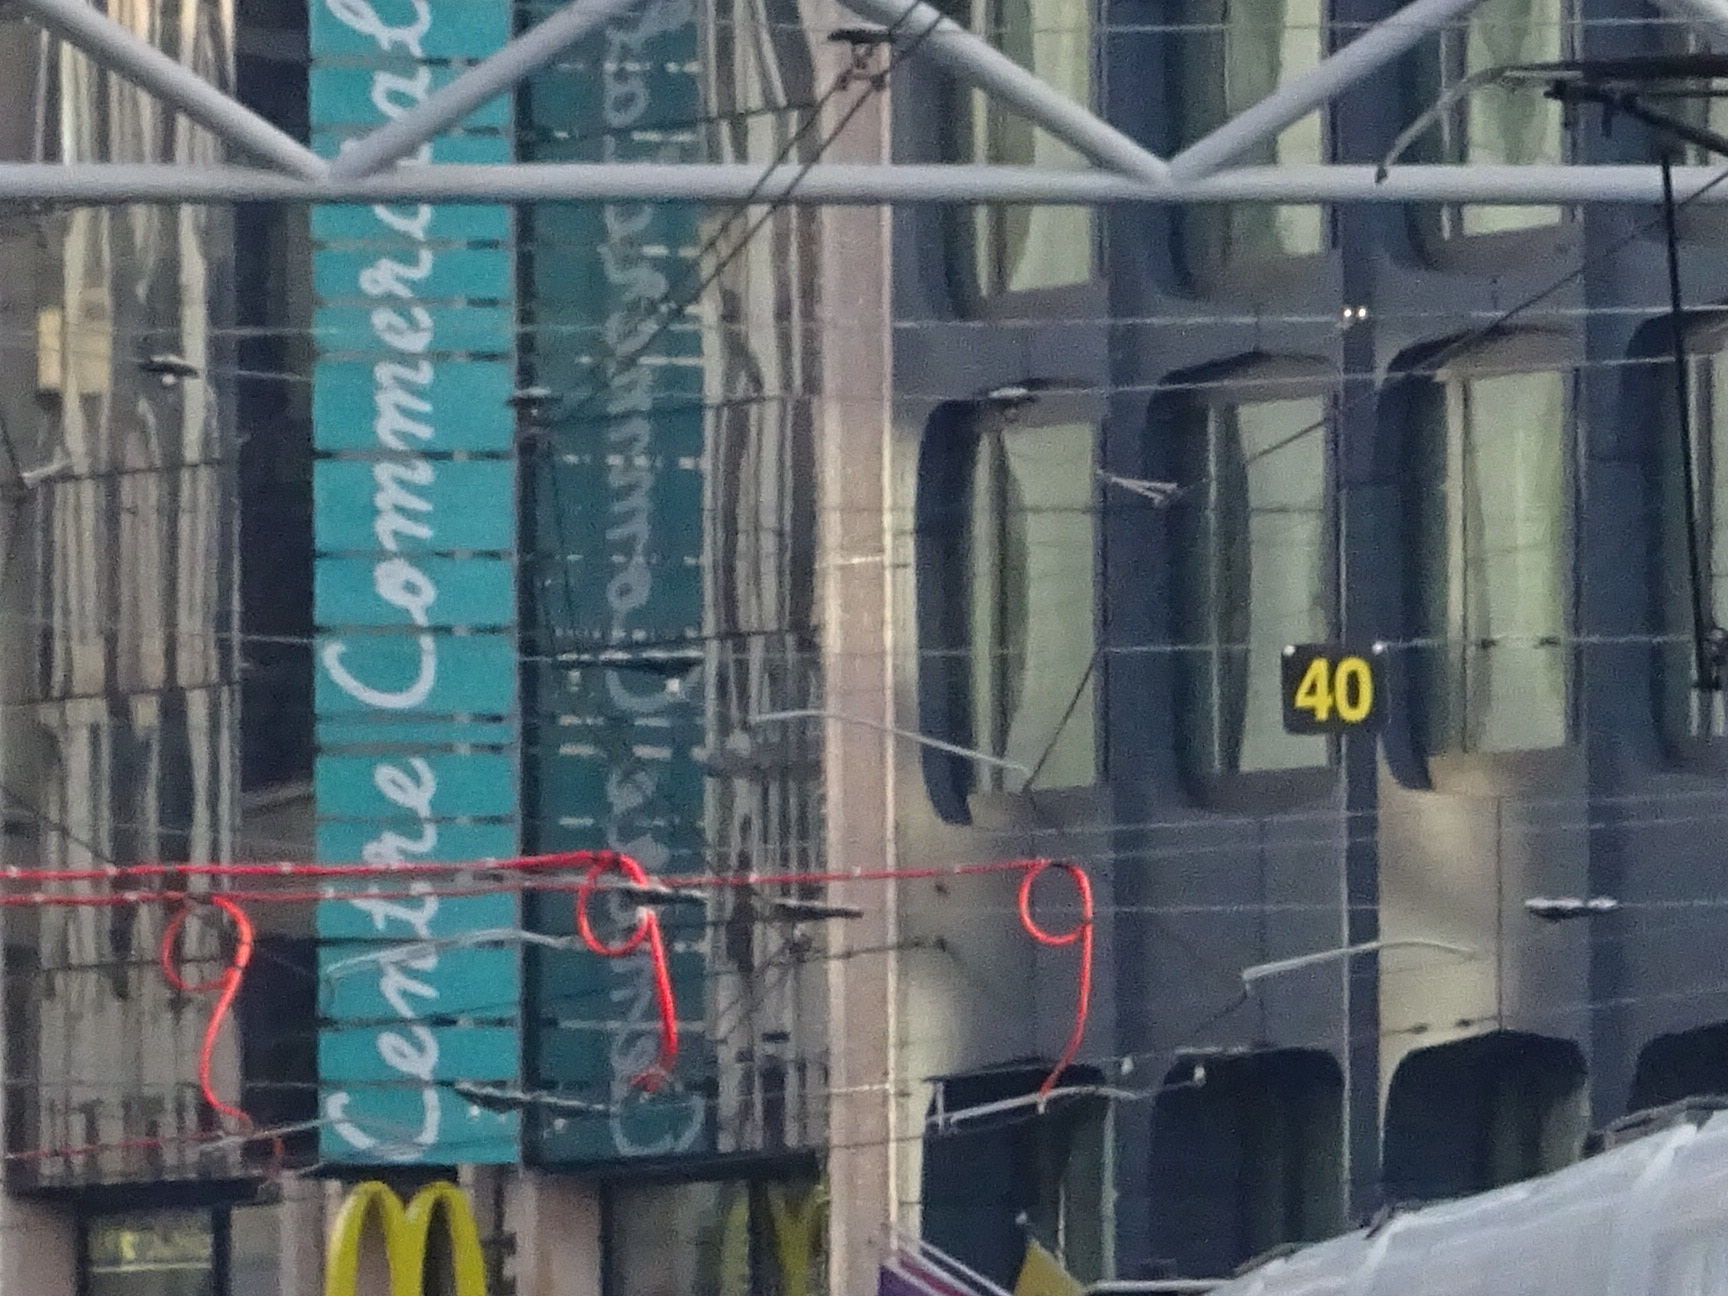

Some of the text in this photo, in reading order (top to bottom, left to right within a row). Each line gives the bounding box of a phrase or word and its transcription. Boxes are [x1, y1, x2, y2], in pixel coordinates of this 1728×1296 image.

[319, 0, 441, 1161] Centre Commercal
[1294, 656, 1374, 722] 40
